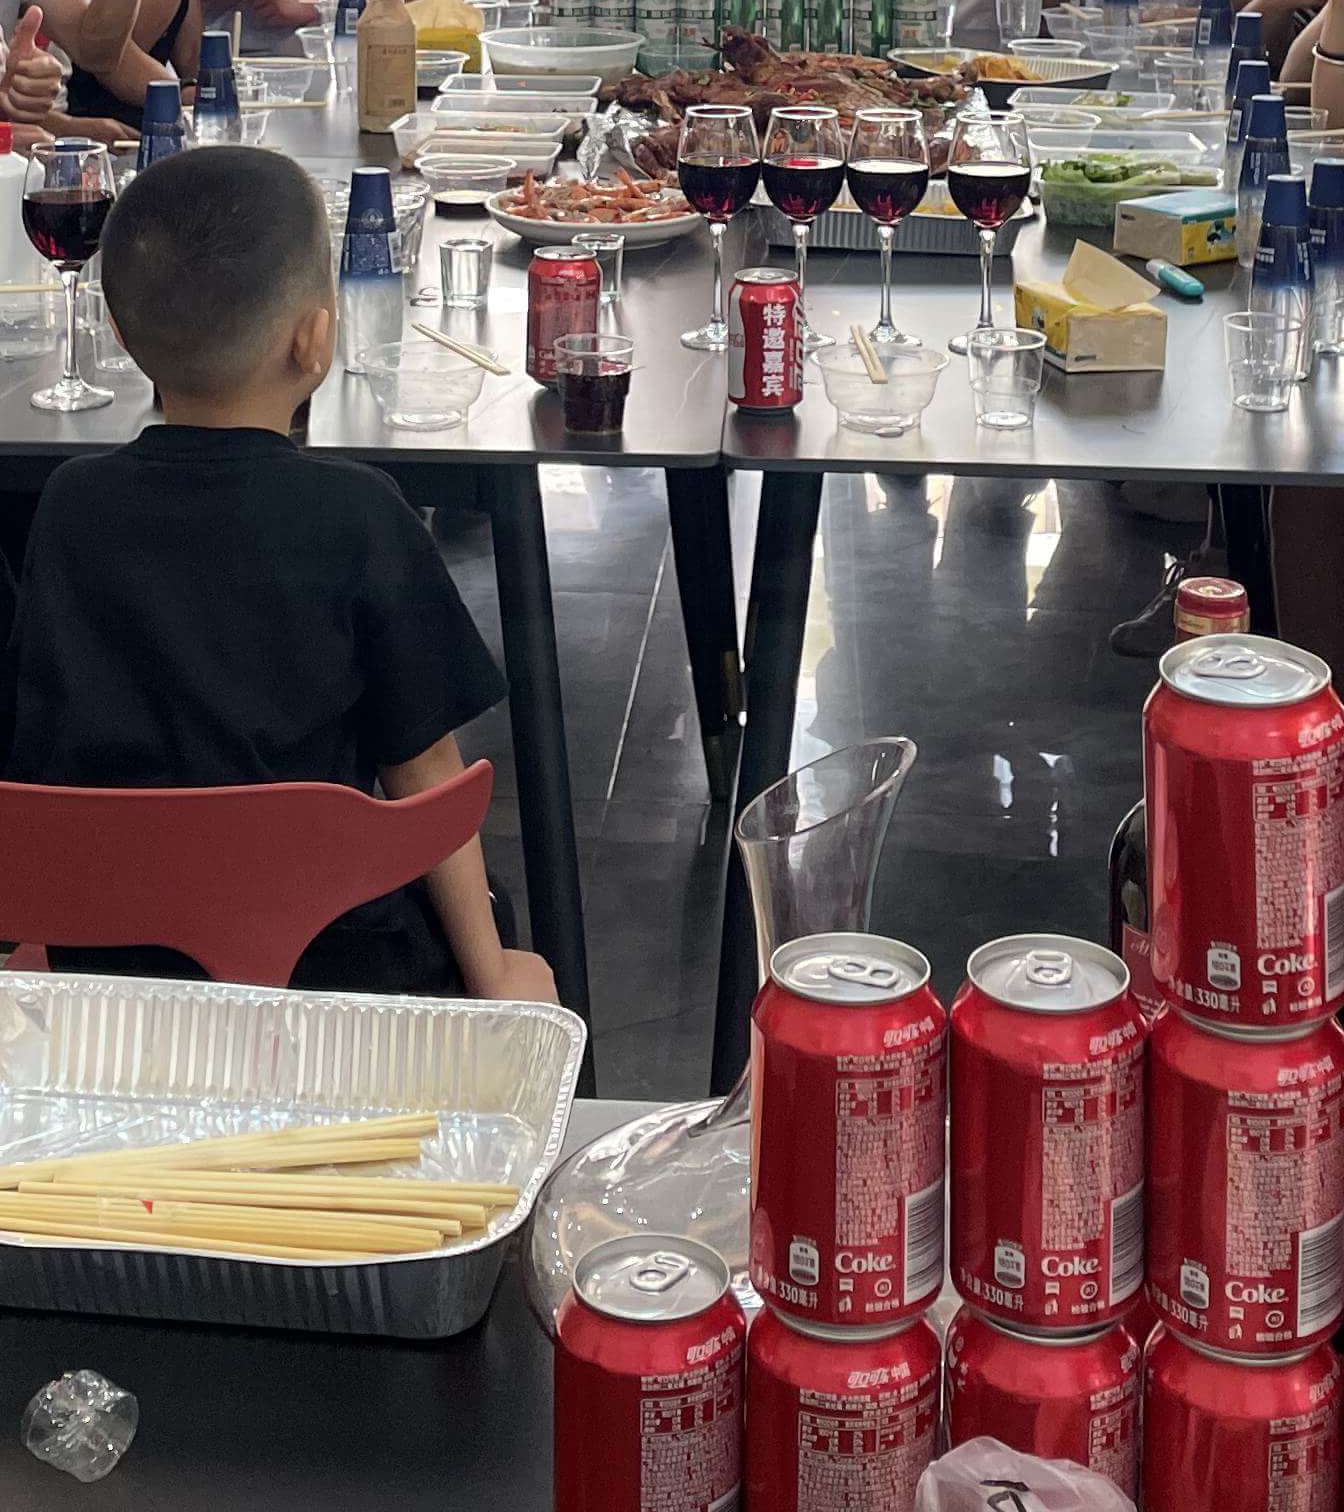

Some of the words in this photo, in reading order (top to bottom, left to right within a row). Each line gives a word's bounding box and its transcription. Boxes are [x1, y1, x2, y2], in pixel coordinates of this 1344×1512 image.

[762, 303, 787, 398] 特邀嘉宾
[1256, 953, 1315, 976] Coke
[835, 1251, 894, 1274] Coke
[1040, 1256, 1099, 1278] Coke
[1224, 1280, 1286, 1304] Coke
